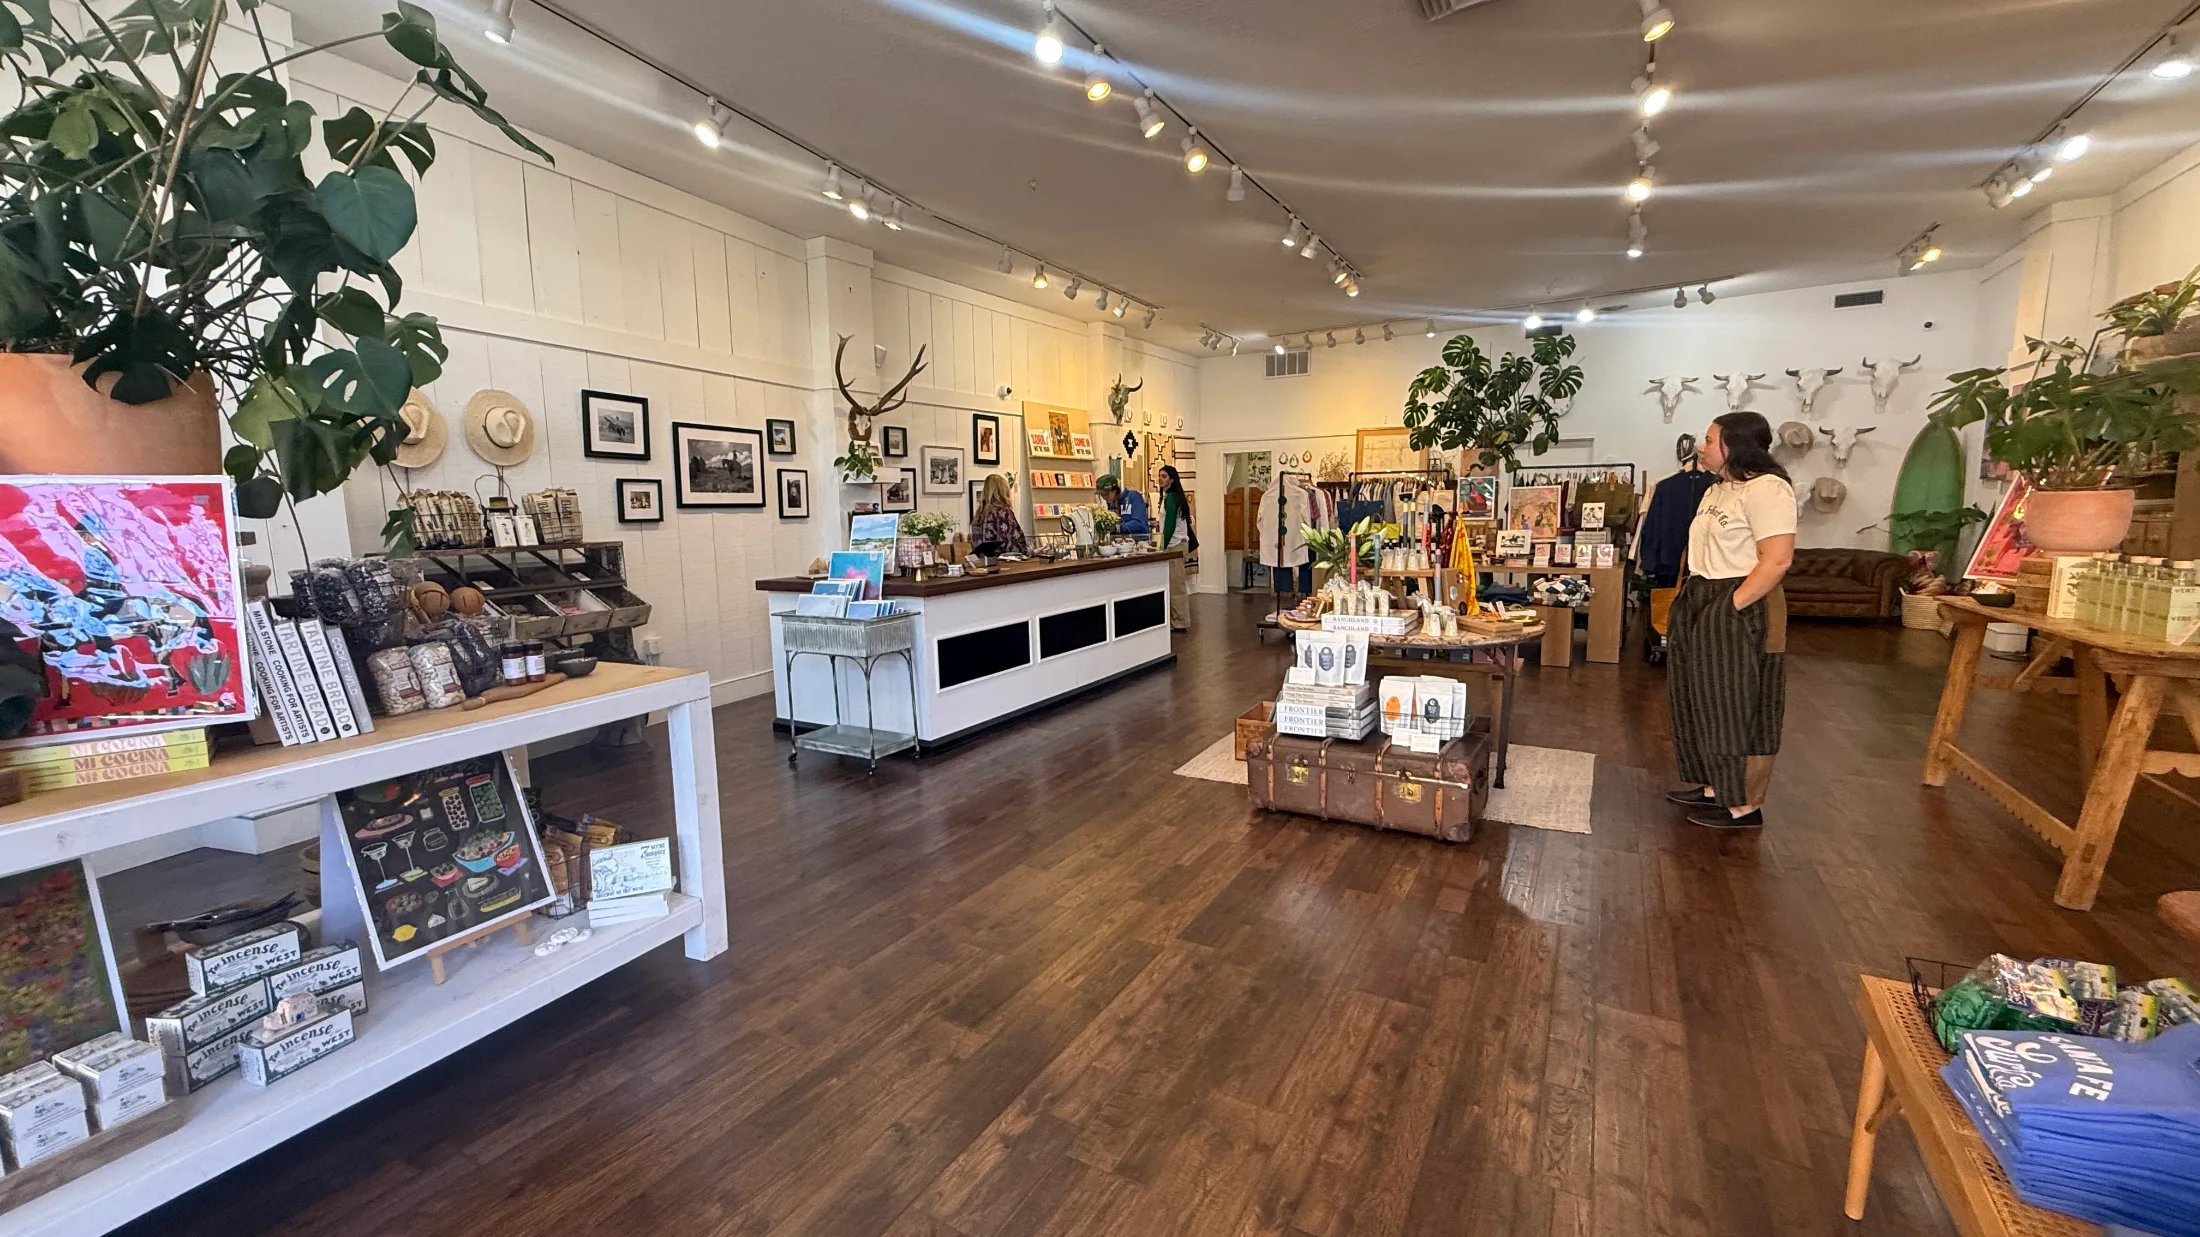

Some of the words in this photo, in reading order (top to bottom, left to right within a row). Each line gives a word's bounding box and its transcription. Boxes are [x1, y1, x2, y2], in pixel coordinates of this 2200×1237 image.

[252, 610, 265, 630] MINA
[261, 630, 277, 655] STONE
[272, 659, 292, 696] COOKING
[286, 692, 298, 708] FOR
[292, 706, 310, 739] ARTISTS
[255, 661, 272, 696] COOKING
[279, 624, 312, 680] TARTINE
[301, 683, 330, 728] BREAD
[303, 622, 335, 678] TARTINE
[325, 680, 351, 724] BREAD
[269, 695, 282, 712] FOR
[1284, 705, 1325, 716] FRONTIER
[275, 711, 294, 741] ARTISTS
[1284, 715, 1325, 726] FRONTIER
[74, 757, 96, 771] MI
[100, 748, 170, 767] COCINA
[75, 769, 98, 784] MI
[102, 760, 171, 779] COCINA
[640, 845, 650, 859] 7
[221, 943, 279, 965] incense
[266, 950, 297, 965] WEST
[286, 960, 341, 981] incense
[329, 966, 358, 981] WEST
[198, 993, 248, 1021] incense
[237, 999, 264, 1017] WEST
[201, 1029, 254, 1059] incense
[280, 1024, 333, 1051] incense
[321, 1029, 350, 1047] WEST
[2069, 1074, 2114, 1101] FE
